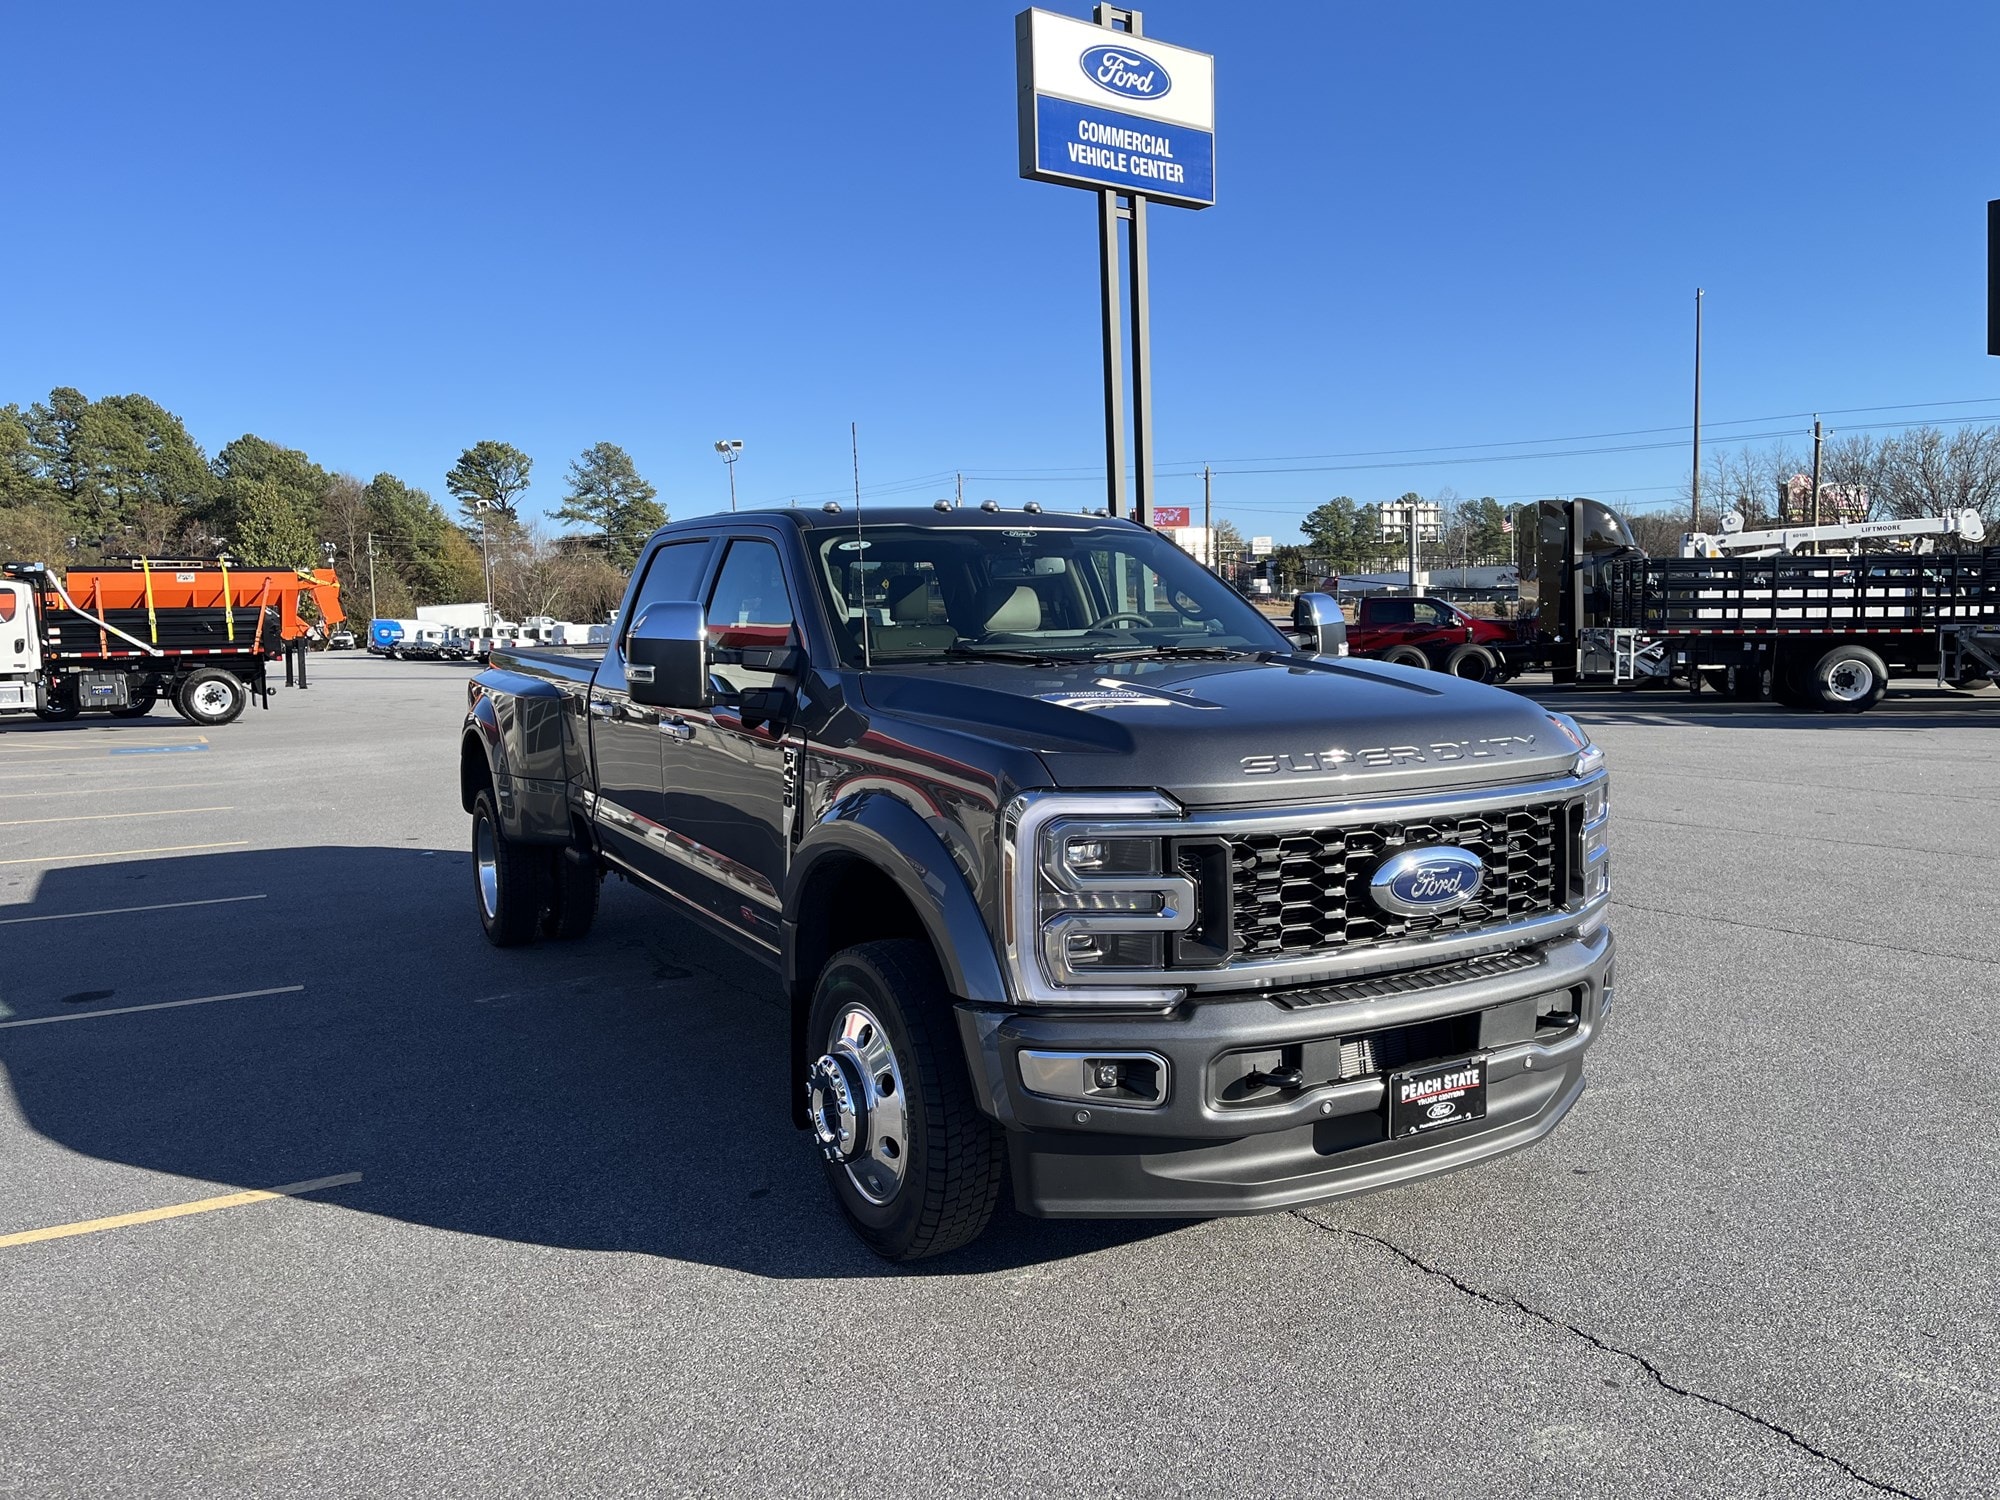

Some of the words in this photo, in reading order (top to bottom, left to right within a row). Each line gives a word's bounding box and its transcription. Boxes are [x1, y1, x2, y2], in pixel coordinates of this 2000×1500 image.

[1097, 52, 1154, 93] Ford
[1078, 119, 1173, 158] COMMERCIAL
[1068, 141, 1127, 172] VEHICLE
[1130, 156, 1184, 183] CENTER
[1861, 525, 1901, 533] LIFTMOORE
[1240, 746, 1426, 775] SUPER
[1430, 734, 1536, 762] DUTY
[1411, 867, 1463, 899] Ford
[1401, 1078, 1441, 1100] PEACH
[1444, 1069, 1479, 1088] STATE
[1417, 1095, 1438, 1106] TRUCK
[1439, 1090, 1465, 1101] CENTERS
[1431, 1104, 1451, 1117] Ford
